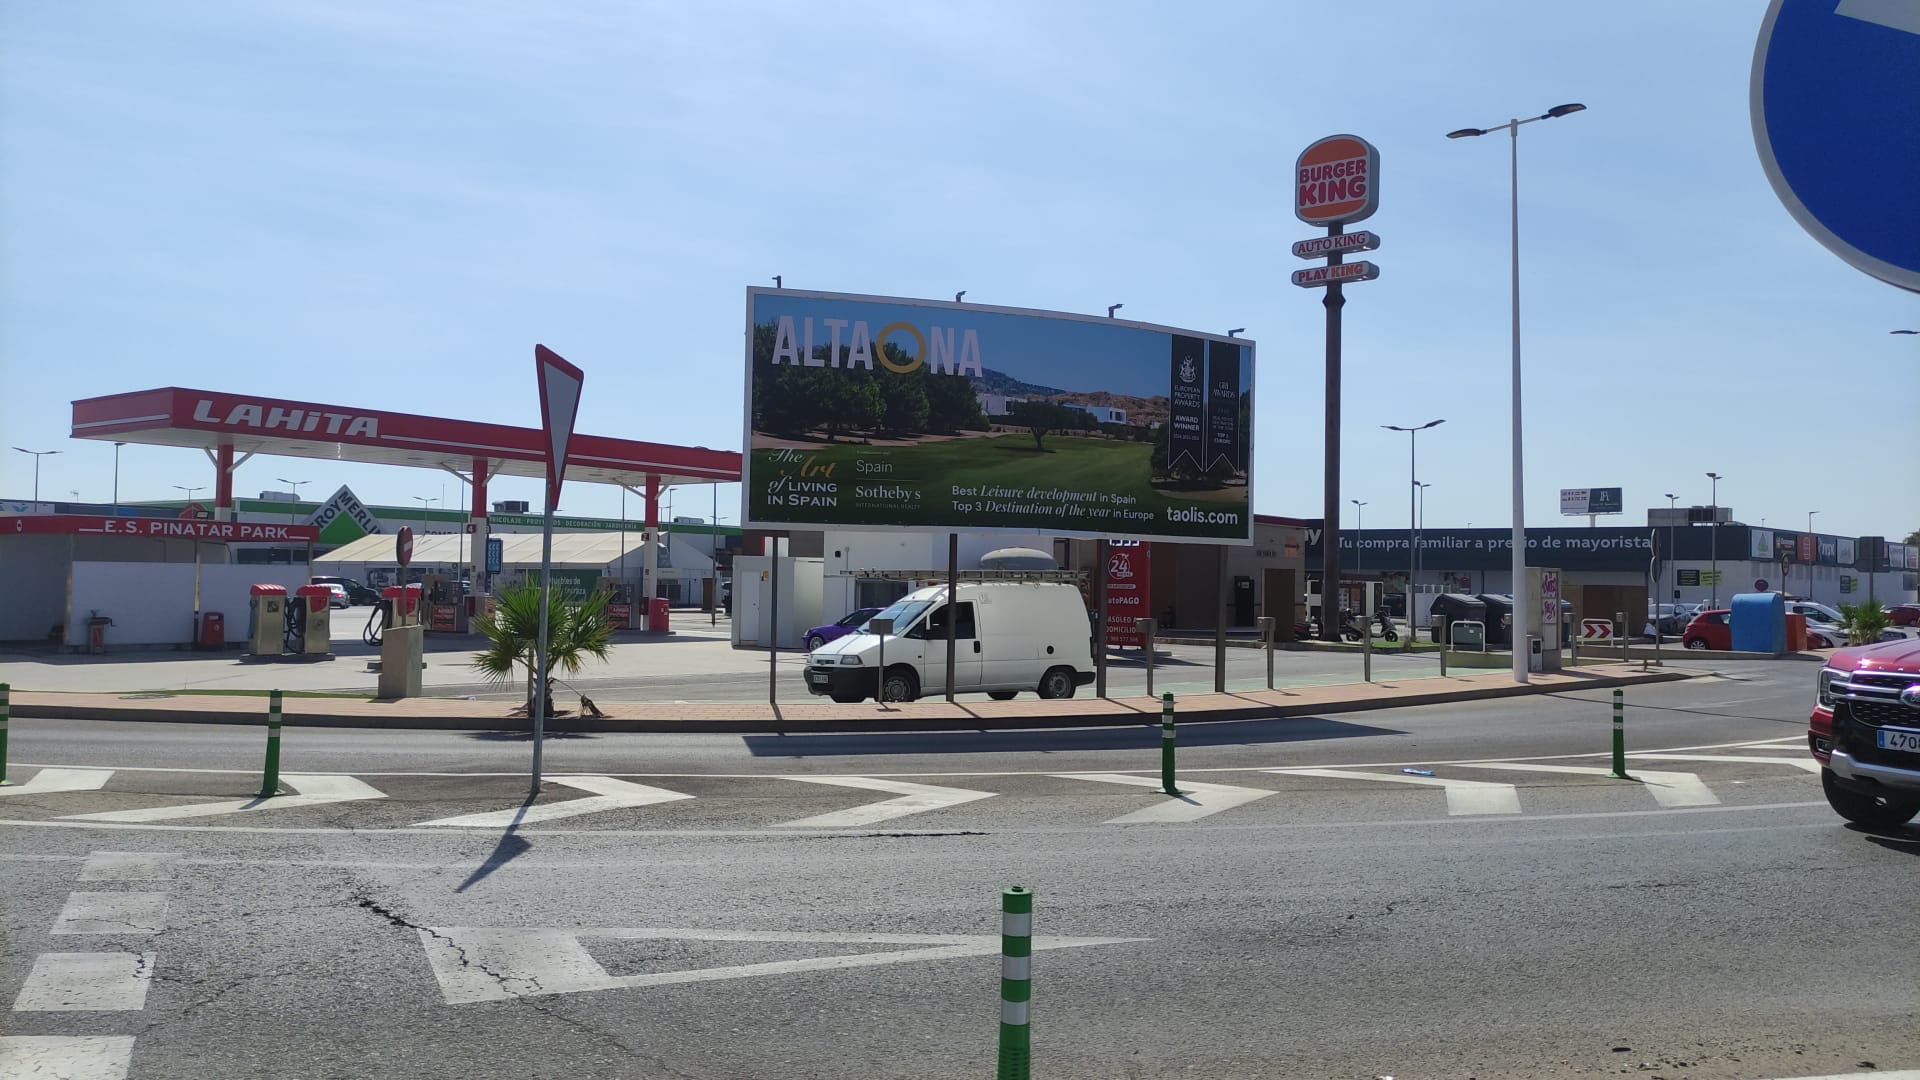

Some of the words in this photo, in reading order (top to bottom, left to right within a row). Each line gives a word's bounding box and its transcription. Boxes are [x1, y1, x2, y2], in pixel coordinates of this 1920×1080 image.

[1300, 159, 1366, 184] BURGER
[1299, 175, 1366, 207] KING
[1297, 238, 1332, 254] AUTO
[1334, 233, 1366, 248] KING
[1298, 268, 1328, 282] PLAY
[1331, 263, 1364, 278] KING
[771, 315, 983, 378] ALTAONA
[1174, 398, 1201, 408] AWARDS
[1173, 421, 1200, 431] WINNER
[1175, 415, 1199, 424] AWARD
[768, 448, 802, 463] The
[780, 455, 838, 479] Art
[856, 459, 893, 475] Spain
[767, 474, 792, 494] of
[855, 485, 921, 503] Sothebys
[952, 485, 977, 496] Best
[980, 485, 1024, 498] Leisure
[1027, 487, 1098, 503] development
[1100, 492, 1108, 503] in
[1111, 493, 1136, 506] Spain
[310, 498, 342, 530] ROY
[338, 491, 382, 534] MERLI
[952, 500, 972, 514] Top
[975, 501, 982, 512] 3
[985, 500, 1052, 515] Destination
[1055, 503, 1069, 518] of
[1069, 504, 1086, 517] the
[1087, 507, 1112, 519] year
[1113, 509, 1122, 519] in
[1123, 509, 1154, 521] Europe
[1166, 506, 1238, 525] taolis.com
[105, 520, 143, 534] E.S.
[150, 522, 233, 537] PINATAR
[241, 525, 289, 539] PARK
[526, 518, 561, 526] PROYOS
[1357, 538, 1410, 552] compra
[1414, 536, 1471, 548] familiar
[1475, 540, 1483, 548] a
[1488, 536, 1537, 552] preio
[1542, 535, 1561, 549] de
[1566, 535, 1650, 552] mayorista
[1110, 560, 1127, 572] 24
[1107, 596, 1140, 605] utoPAGO
[1107, 615, 1132, 624] ASOLEO
[1890, 733, 1920, 750] 470
